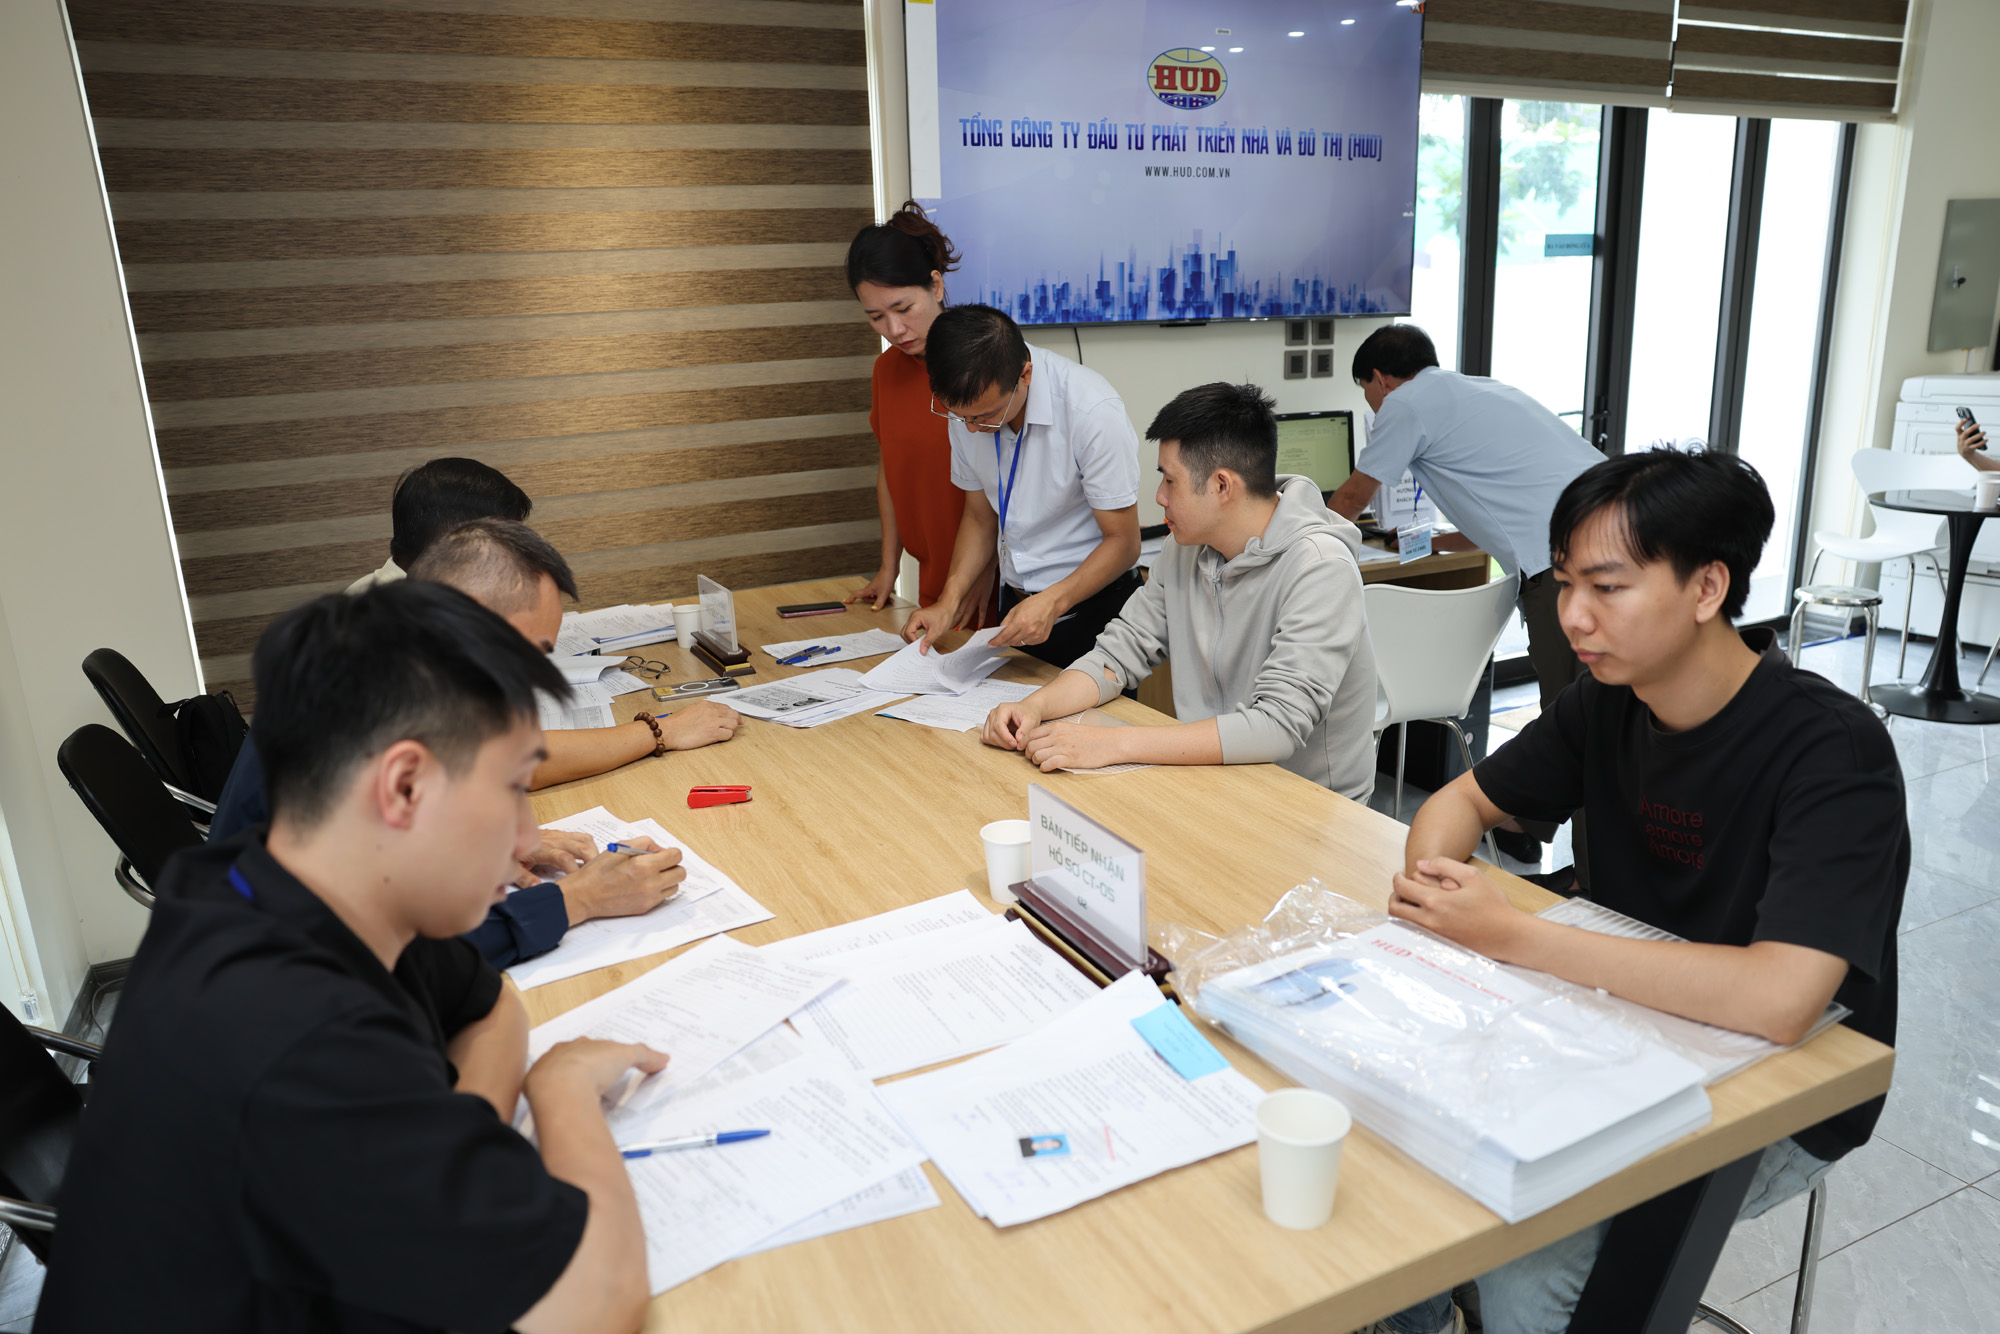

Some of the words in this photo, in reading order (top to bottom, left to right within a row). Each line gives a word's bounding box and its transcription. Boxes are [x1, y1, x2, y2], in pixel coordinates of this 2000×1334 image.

[1154, 64, 1221, 92] HUD
[959, 112, 1003, 147] TỔNG
[1011, 116, 1053, 148] CÔNG
[1060, 121, 1080, 149] TY
[1087, 117, 1118, 150] ĐẦU
[1125, 122, 1146, 151] TƯ
[1152, 122, 1190, 152] PHÁT
[1195, 121, 1235, 154] TRIỂN
[1241, 126, 1269, 155] NHÀ
[1275, 127, 1292, 156] VÀ
[1298, 128, 1316, 157] ĐÔ
[1322, 132, 1343, 161] THỊ
[1145, 166, 1231, 179] WWW.HUD.COM.VN
[1640, 794, 1703, 829] Amore
[1041, 814, 1063, 840] BÀN
[1064, 829, 1088, 855] TIẾP
[1091, 846, 1125, 882] NHẬN
[1048, 844, 1063, 866] HỒ
[1065, 857, 1080, 878] SƠ
[1371, 939, 1413, 958] HUD
